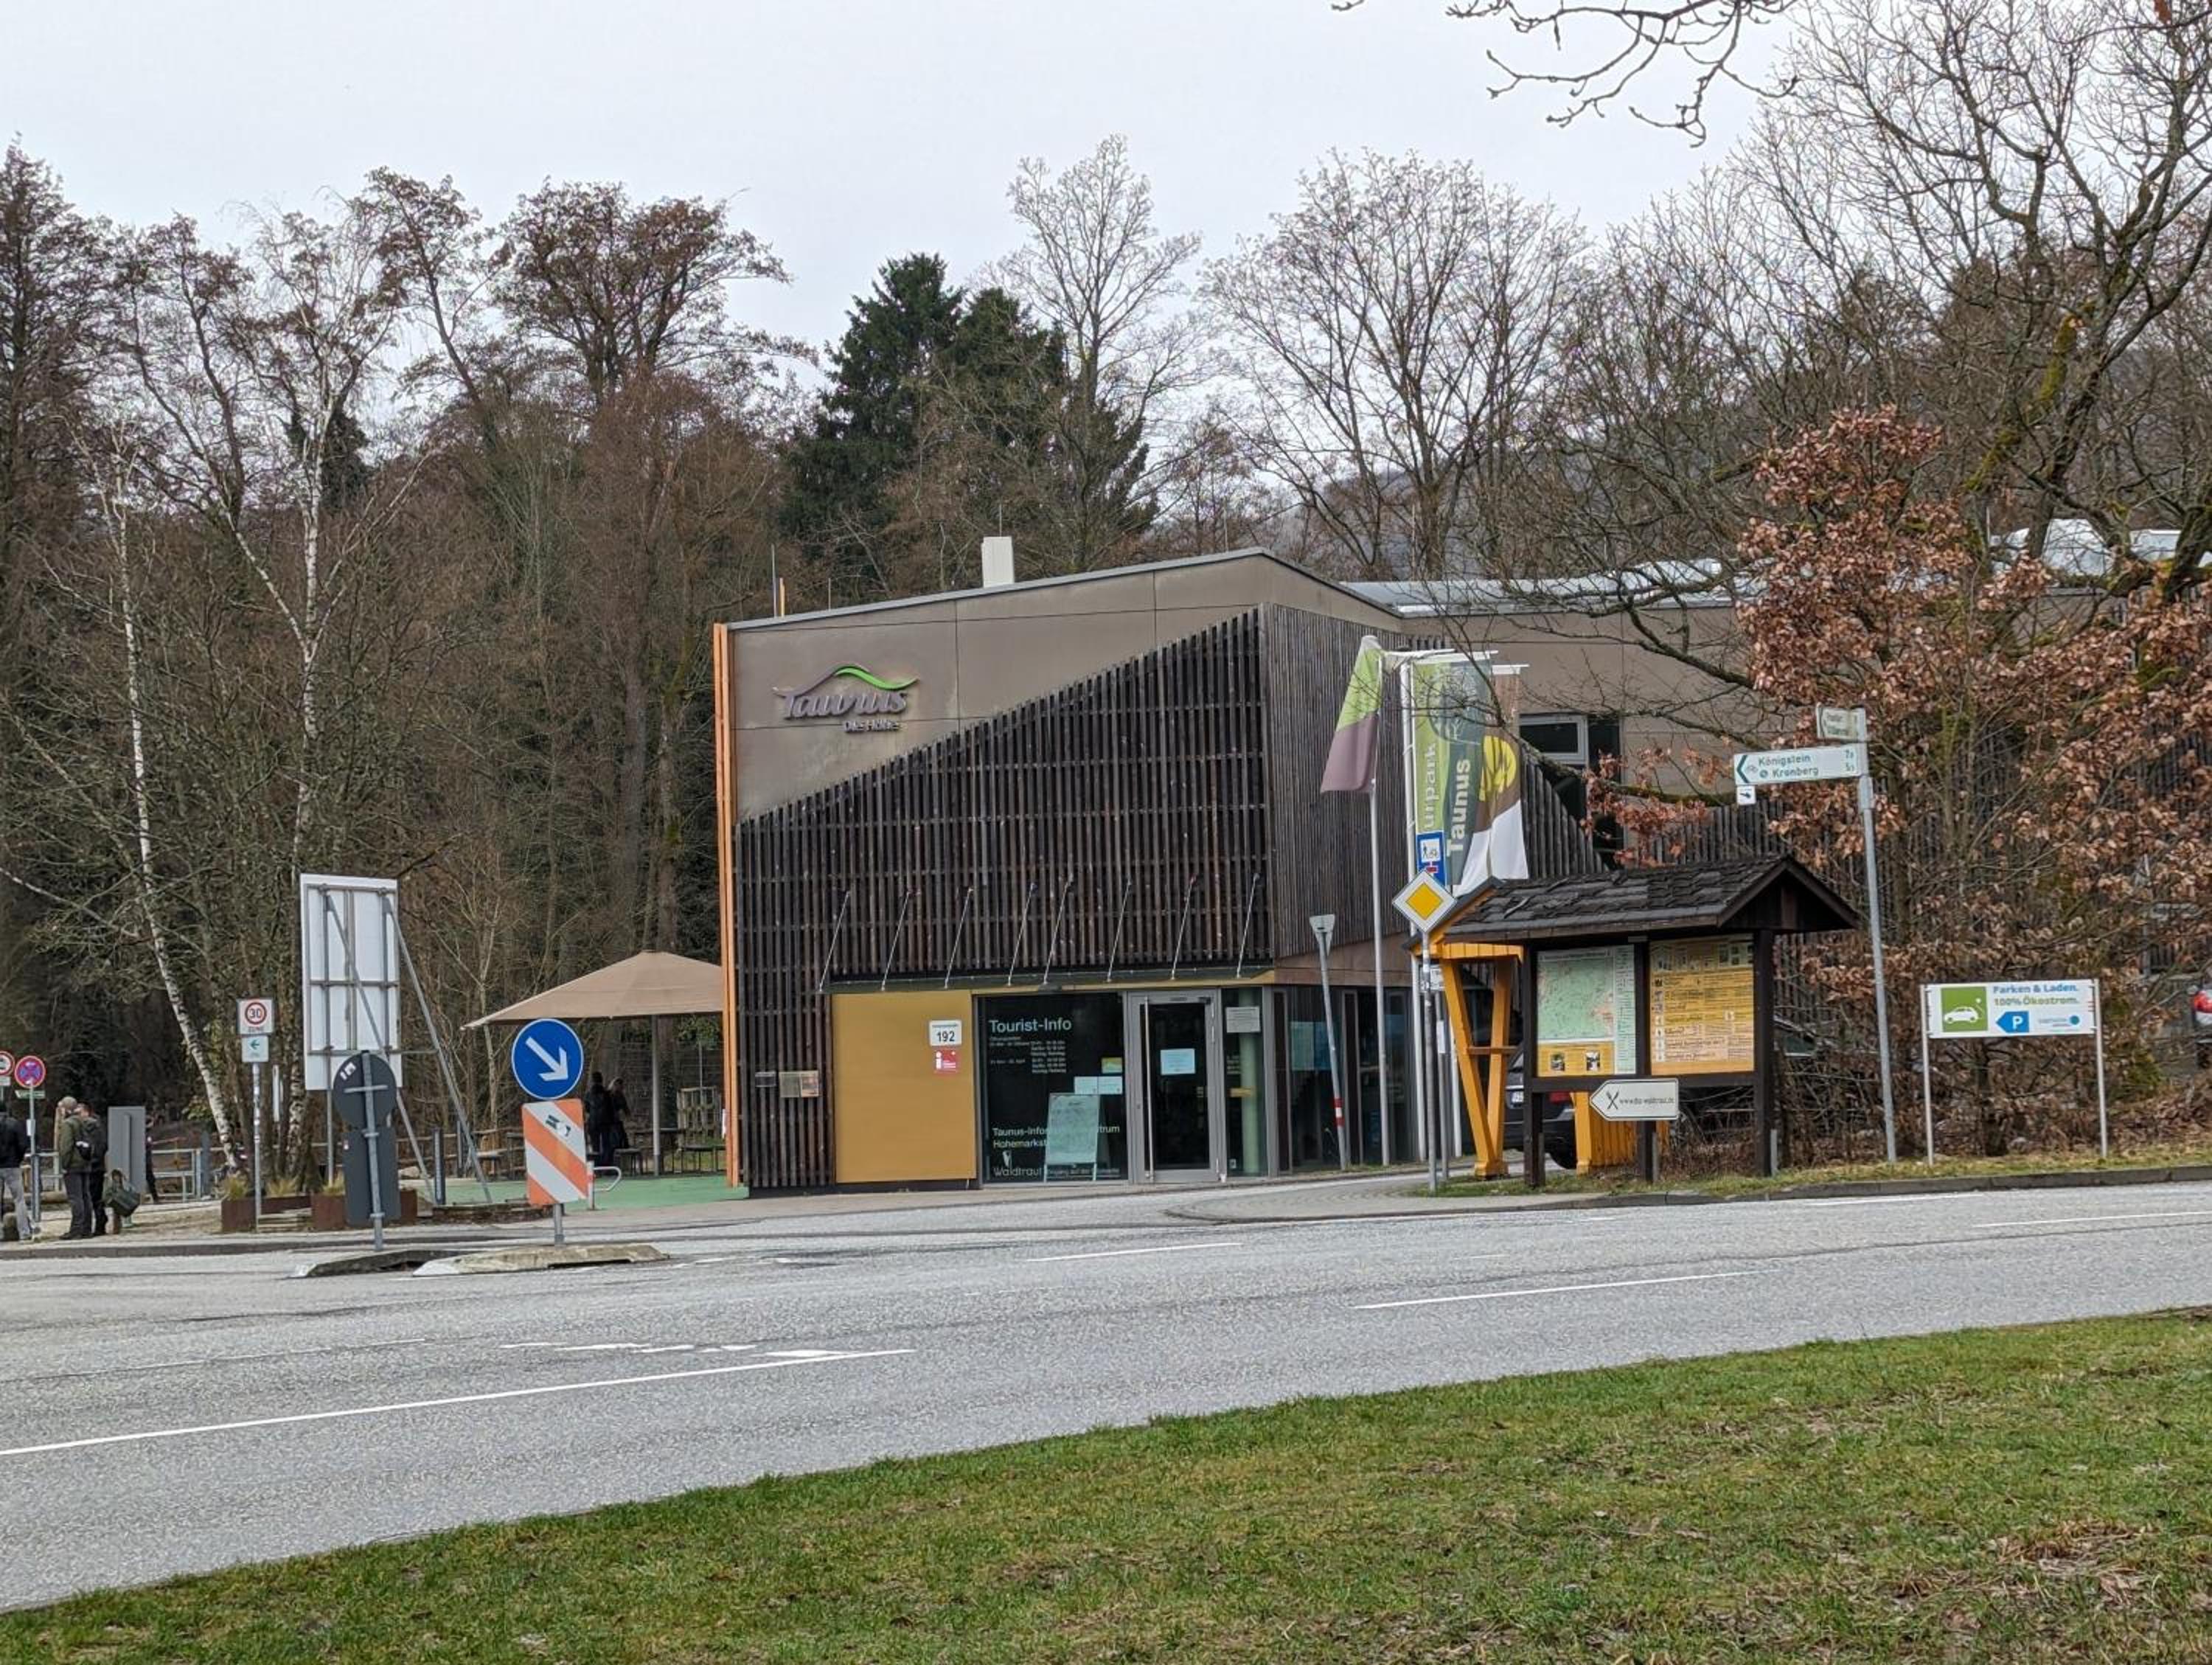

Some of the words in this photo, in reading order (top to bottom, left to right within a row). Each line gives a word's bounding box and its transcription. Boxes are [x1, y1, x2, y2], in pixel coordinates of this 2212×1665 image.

[1759, 754, 1811, 767] Königstein
[1773, 767, 1819, 778] Kronberg
[1447, 759, 1471, 857] Taunus
[1993, 985, 2031, 993] Parken
[2034, 984, 2041, 993] &
[1994, 998, 2022, 1006] 100%
[249, 1008, 263, 1018] 30
[988, 1017, 1072, 1033] Tourist-Info
[2012, 1015, 2023, 1029] P
[936, 1030, 956, 1042] 192
[992, 1126, 1048, 1137] Taunus-Info
[992, 1138, 1048, 1149] Hohemarkst
